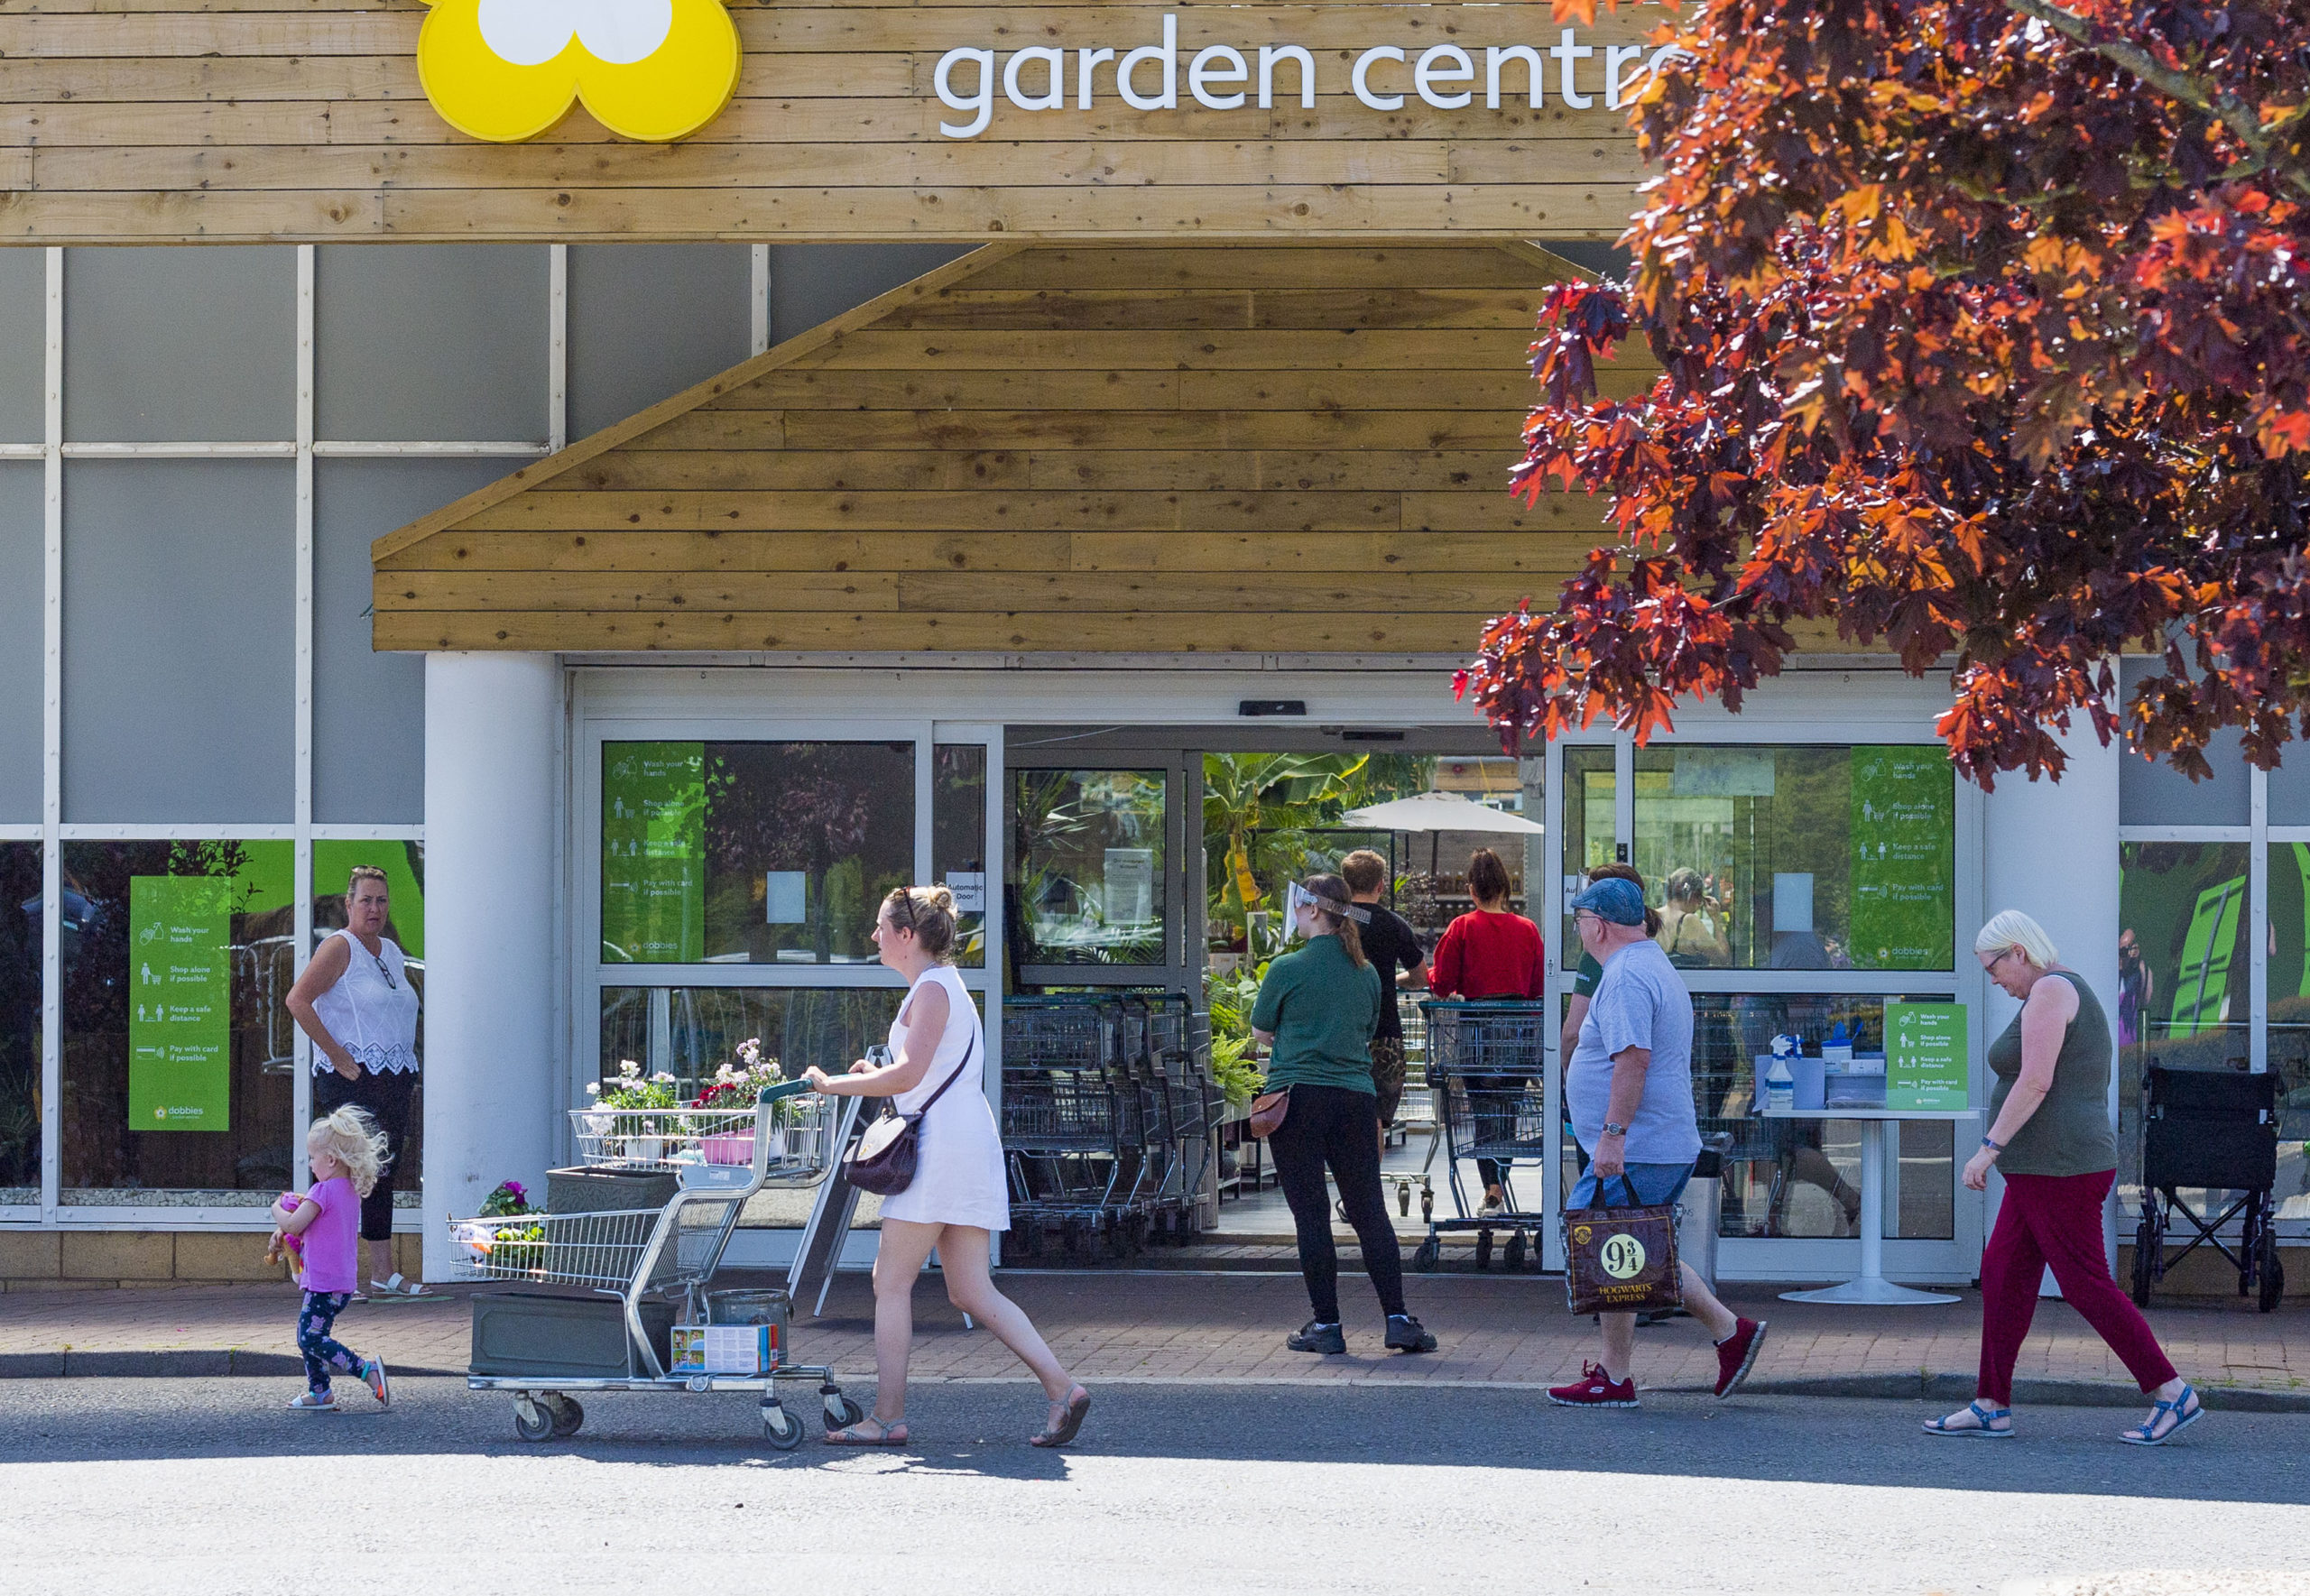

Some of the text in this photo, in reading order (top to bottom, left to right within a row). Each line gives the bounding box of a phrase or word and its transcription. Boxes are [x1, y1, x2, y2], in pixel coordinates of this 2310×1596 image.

[933, 14, 1316, 139] garden
[643, 799, 662, 807] Shop
[1893, 802, 1911, 811] Shop
[651, 808, 681, 817] possible
[1899, 812, 1931, 821] possible
[643, 840, 662, 848] Keep
[1892, 843, 1912, 851] Keep
[643, 880, 657, 888] Pay
[1892, 884, 1906, 892] Pay
[650, 889, 681, 897] possible
[1899, 893, 1931, 901] possible
[1891, 946, 1928, 955] dobbies
[171, 966, 189, 974] Shop
[177, 975, 207, 983] possible
[170, 1005, 189, 1013] Keep
[170, 1045, 182, 1053] Pay
[169, 1106, 203, 1114] dobbies
[1606, 1241, 1625, 1272] 9
[1599, 1283, 1652, 1295] HOGWARTS
[1606, 1292, 1646, 1303] EXPRESS
